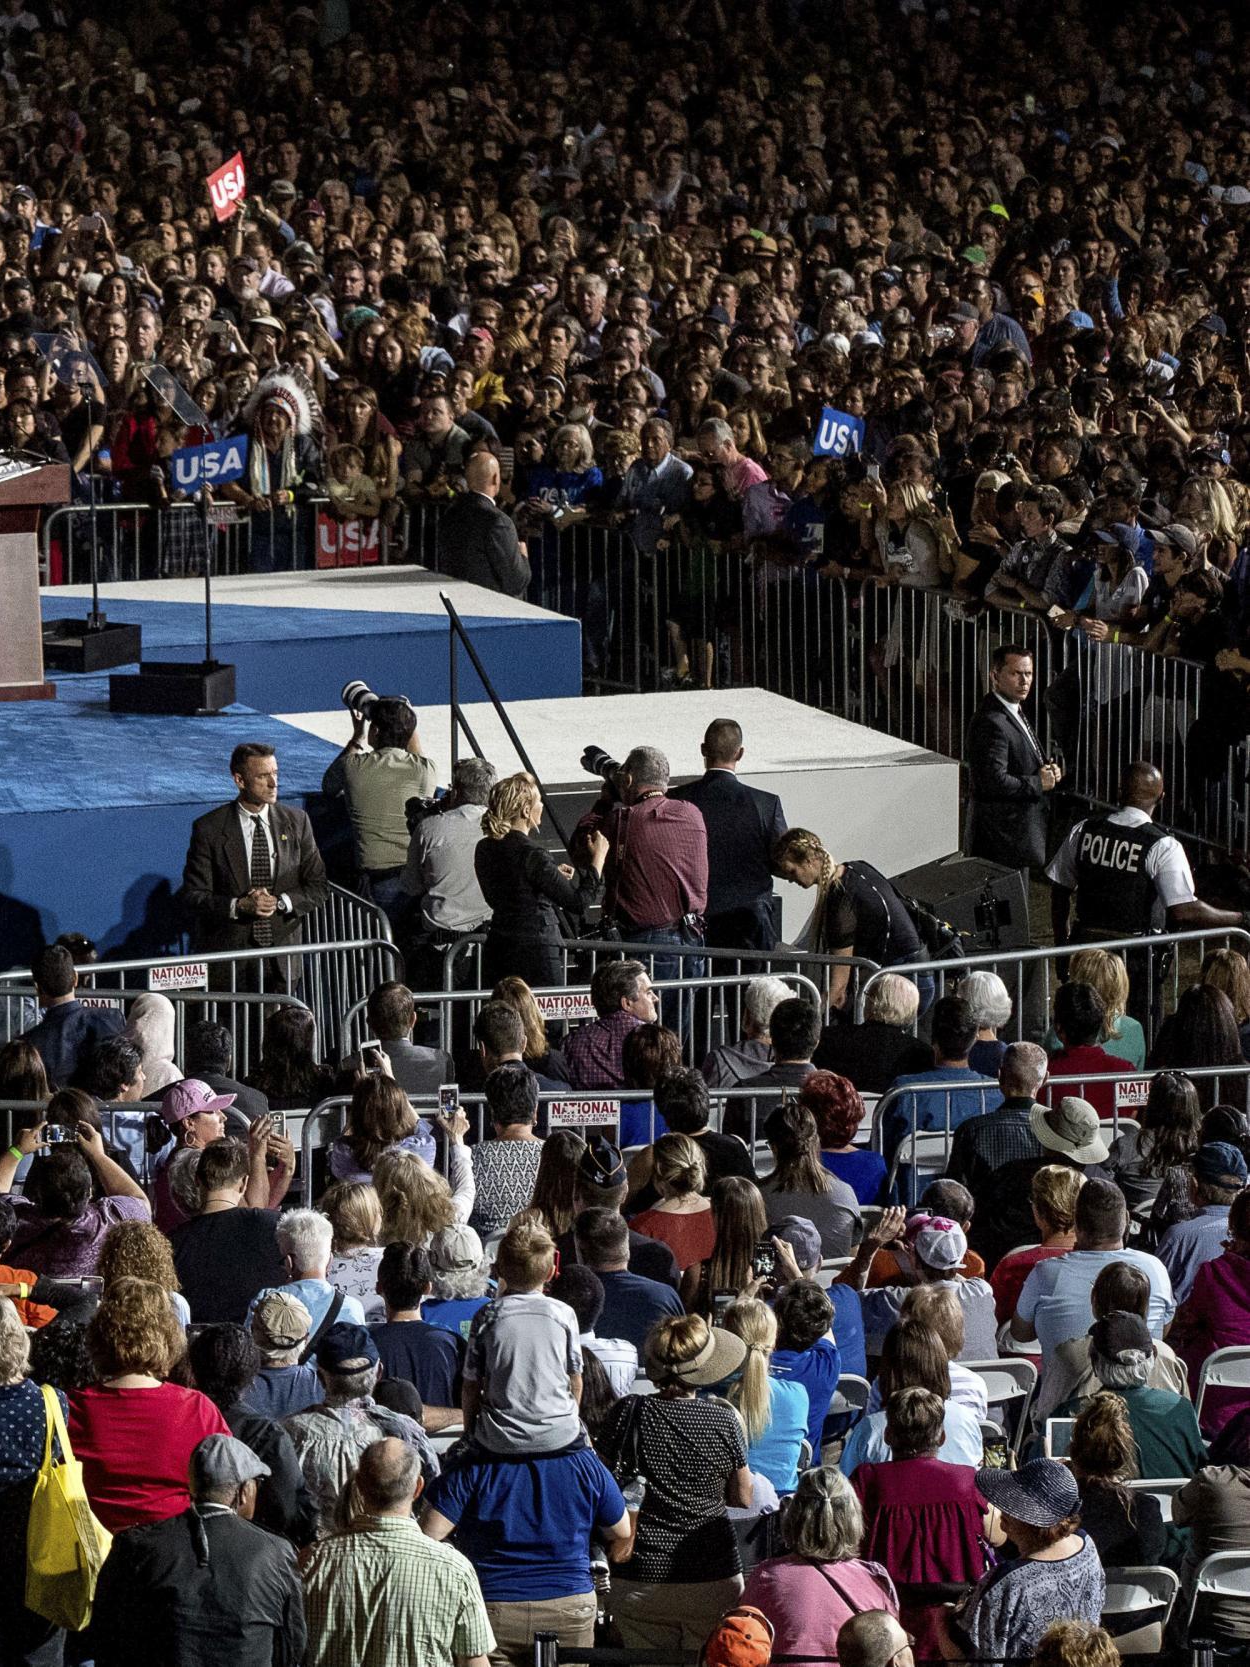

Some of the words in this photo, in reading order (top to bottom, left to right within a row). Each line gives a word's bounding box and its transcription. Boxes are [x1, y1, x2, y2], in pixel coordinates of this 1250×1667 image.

[176, 447, 243, 484] USA
[319, 517, 379, 553] USA
[1080, 833, 1143, 873] POLICE
[152, 964, 206, 980] NATIONAL
[537, 995, 590, 1009] NATIONA
[1118, 1082, 1150, 1095] NATI
[551, 1101, 618, 1115] NATIONAL
